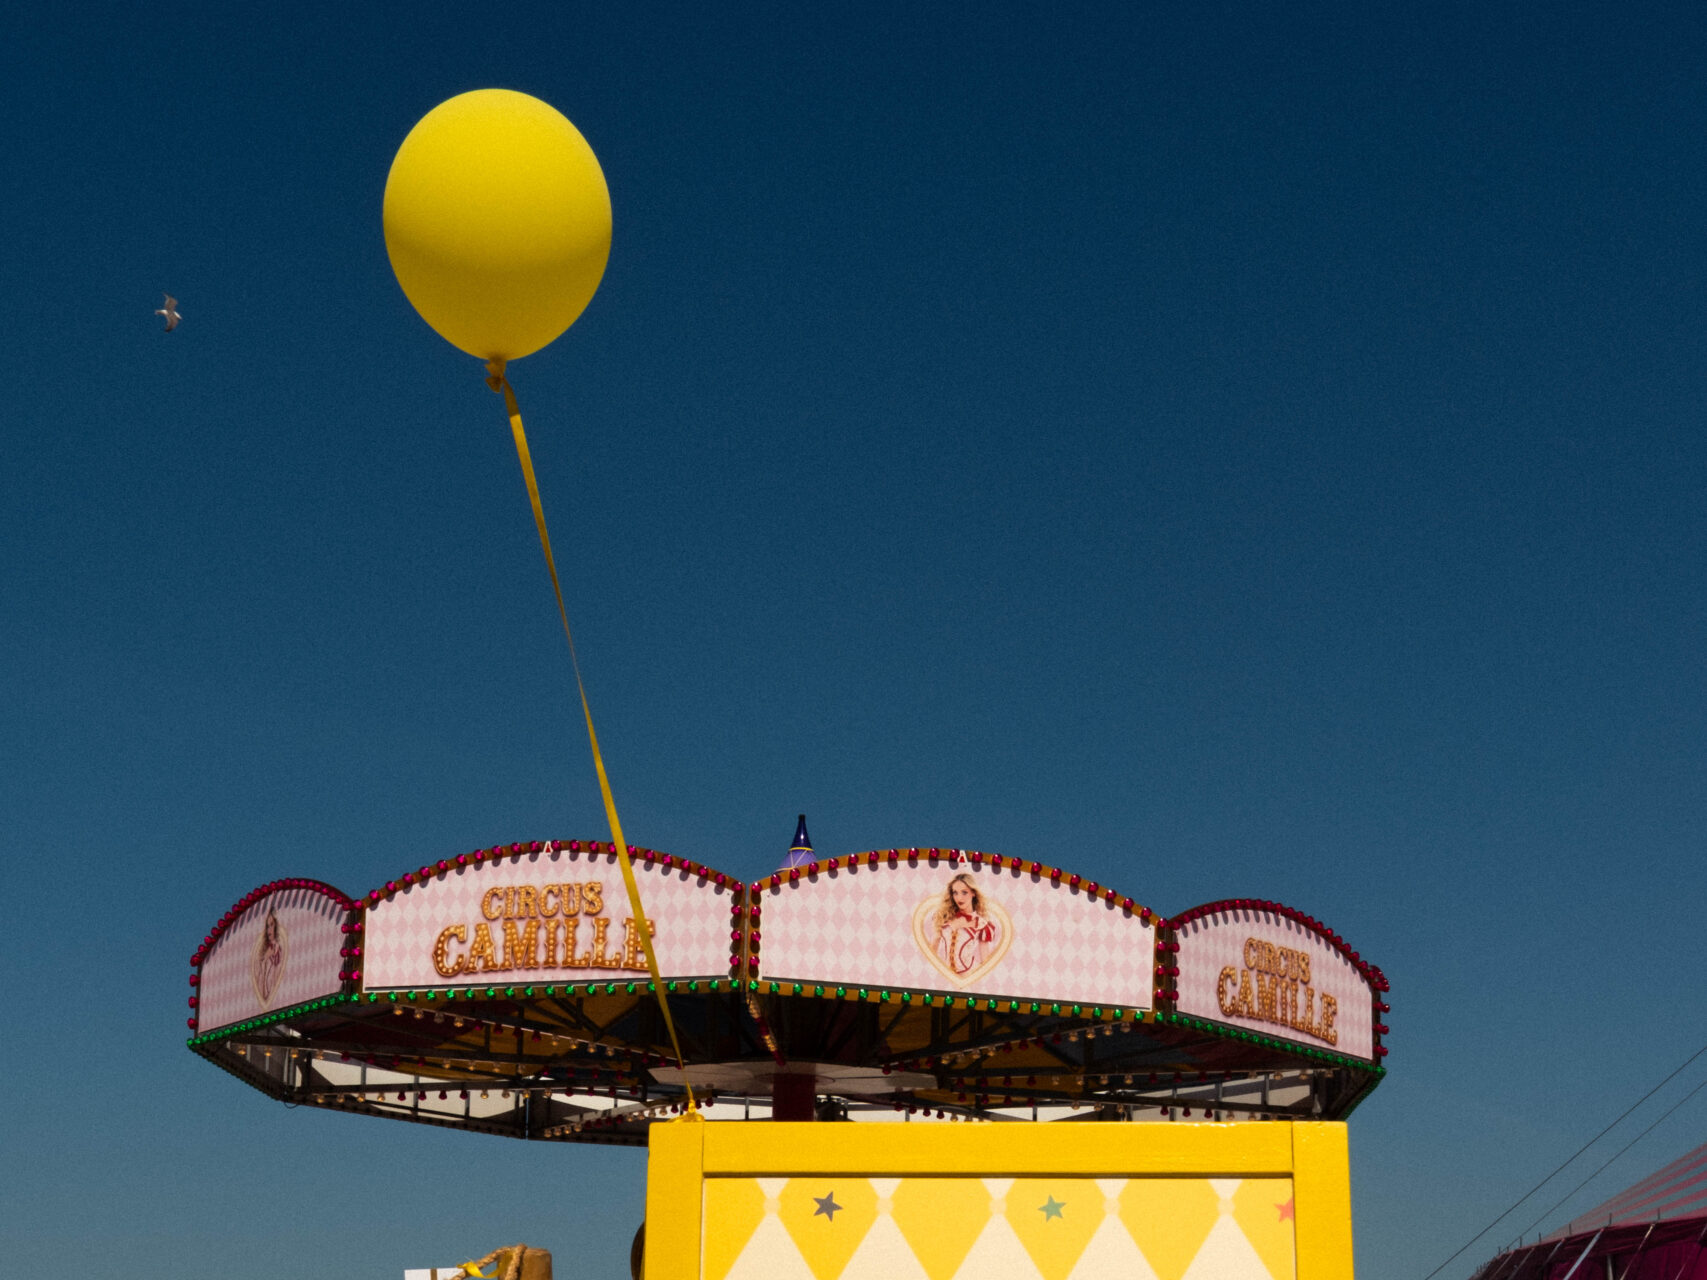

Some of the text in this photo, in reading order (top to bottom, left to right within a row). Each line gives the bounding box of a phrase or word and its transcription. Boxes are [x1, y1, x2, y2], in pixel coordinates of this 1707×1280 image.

[481, 881, 604, 920] CIRCUS
[432, 917, 656, 977] CAMILLE
[1243, 937, 1311, 985] CIRCUS
[1217, 965, 1338, 1046] CAMILLE
